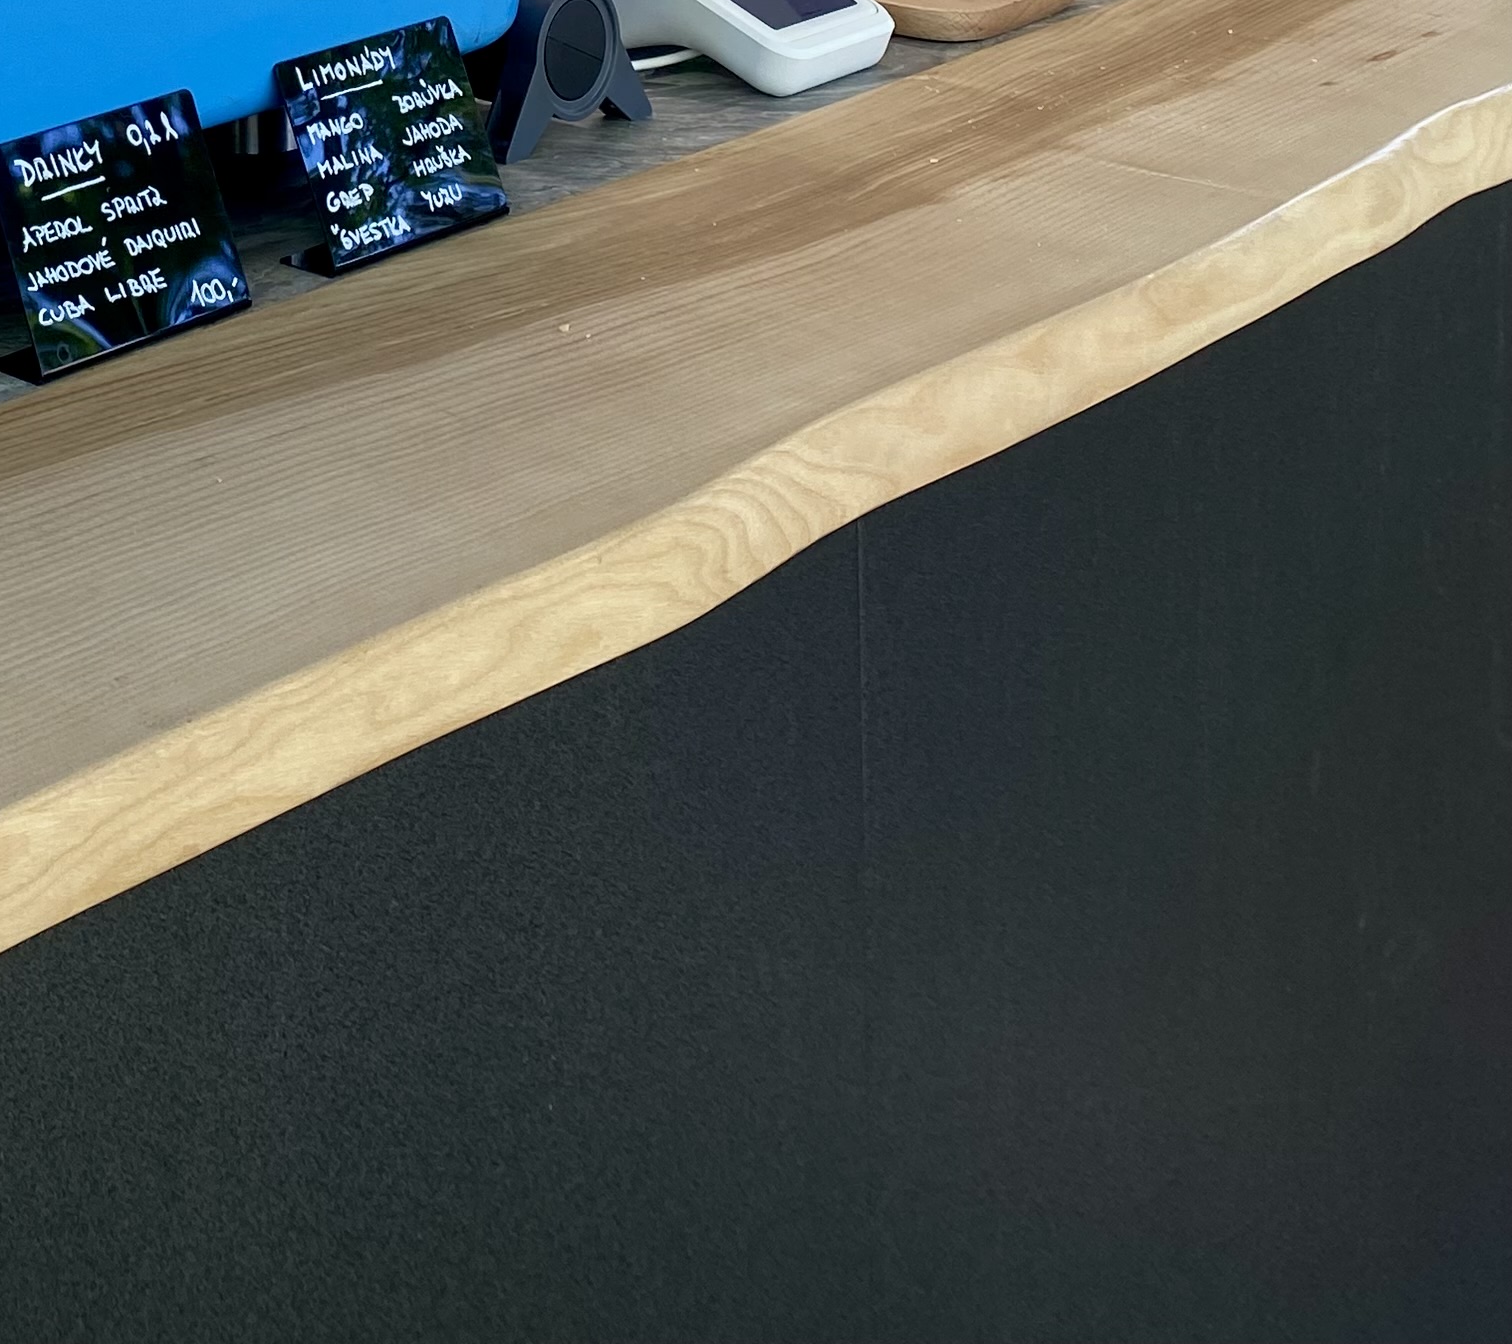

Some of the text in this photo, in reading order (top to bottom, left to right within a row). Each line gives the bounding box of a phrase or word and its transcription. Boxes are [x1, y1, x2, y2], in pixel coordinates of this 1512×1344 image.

[295, 45, 396, 92] LIMONÁDY
[306, 112, 364, 146] MANGO
[402, 114, 464, 147] JAHODA
[14, 140, 104, 188] DRINKY
[316, 144, 384, 180] MALINA
[326, 183, 374, 213] GREP
[420, 183, 463, 213] YUZU
[22, 186, 168, 253] APEROL SPRITZ
[27, 236, 117, 292] JAHODOVÉ
[37, 294, 96, 327] CUBA
[104, 267, 168, 303] LIBRE
